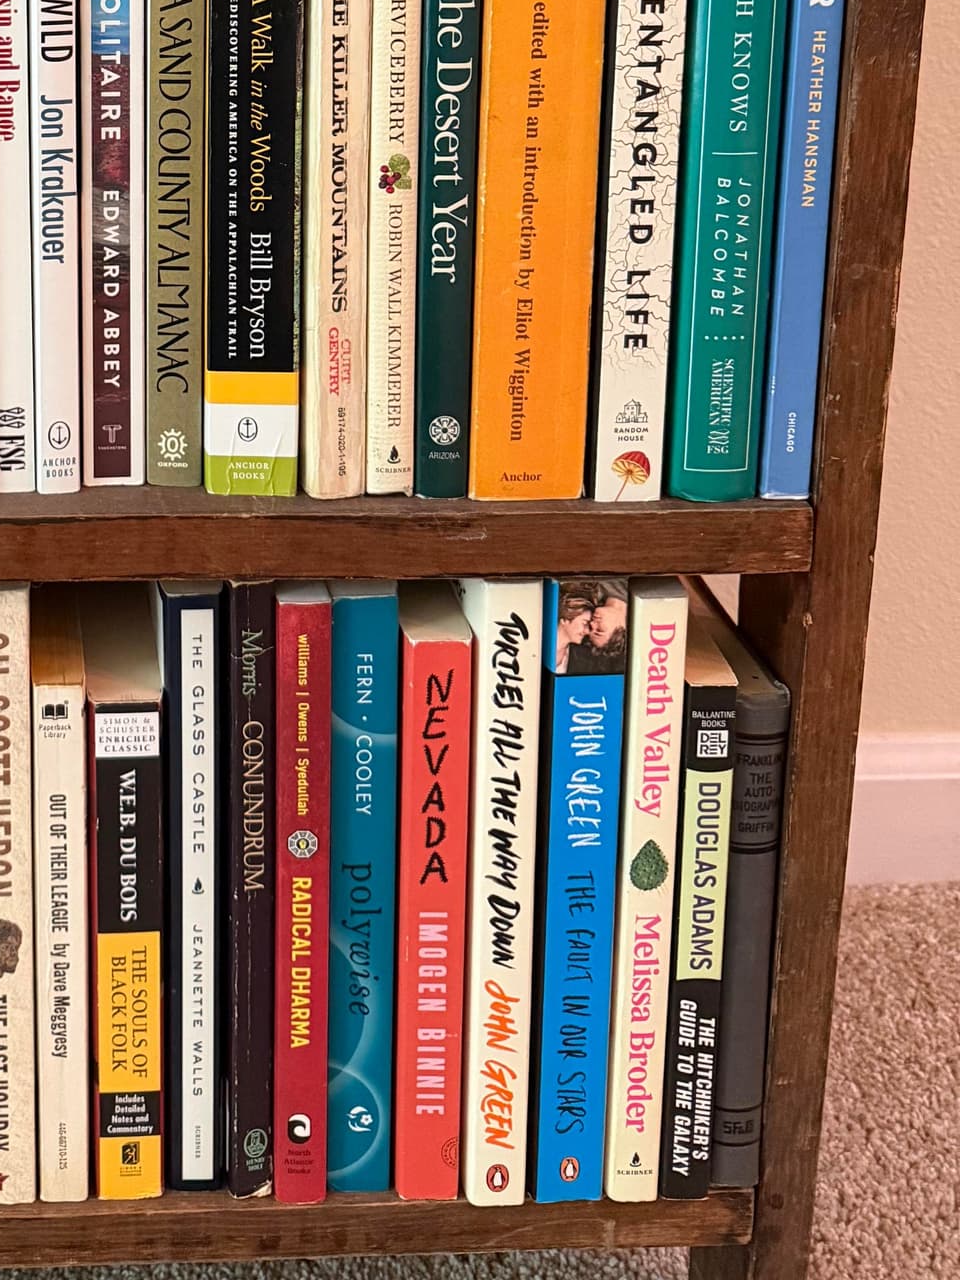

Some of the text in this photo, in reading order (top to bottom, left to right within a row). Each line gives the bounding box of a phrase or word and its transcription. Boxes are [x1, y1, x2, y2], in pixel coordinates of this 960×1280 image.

[40, 95, 72, 139] Jon
[39, 148, 78, 264] Krakauer
[103, 190, 120, 297] EDWARD
[103, 308, 121, 388] ABBEY
[241, 231, 272, 360] Bill Bryson
[42, 458, 76, 468] ANCHOR
[46, 468, 74, 478] BOOKS
[500, 471, 542, 482] Anchor
[614, 426, 649, 434] RANDOM
[617, 434, 644, 442] HOUSE
[786, 412, 797, 453] CHICAGO
[355, 653, 373, 816] FERN COOLEY
[634, 622, 677, 818] Death Valley
[691, 710, 736, 720] BALLANTINE
[699, 744, 726, 755] REY
[700, 733, 726, 744] DEL
[701, 719, 726, 728] BOOKS
[241, 720, 266, 891] CONUNDRUM
[419, 669, 454, 885] NEVADA
[565, 695, 608, 848] JOHN GREEN
[118, 769, 138, 923] W.E.B. DU BOIS
[690, 782, 722, 971] DOUGLAS ADAMS
[191, 924, 204, 1097] JEANNETTE WALLS
[290, 876, 313, 1049] RADICAL DHARMA
[415, 911, 449, 1116] IMOGEN BINNIE
